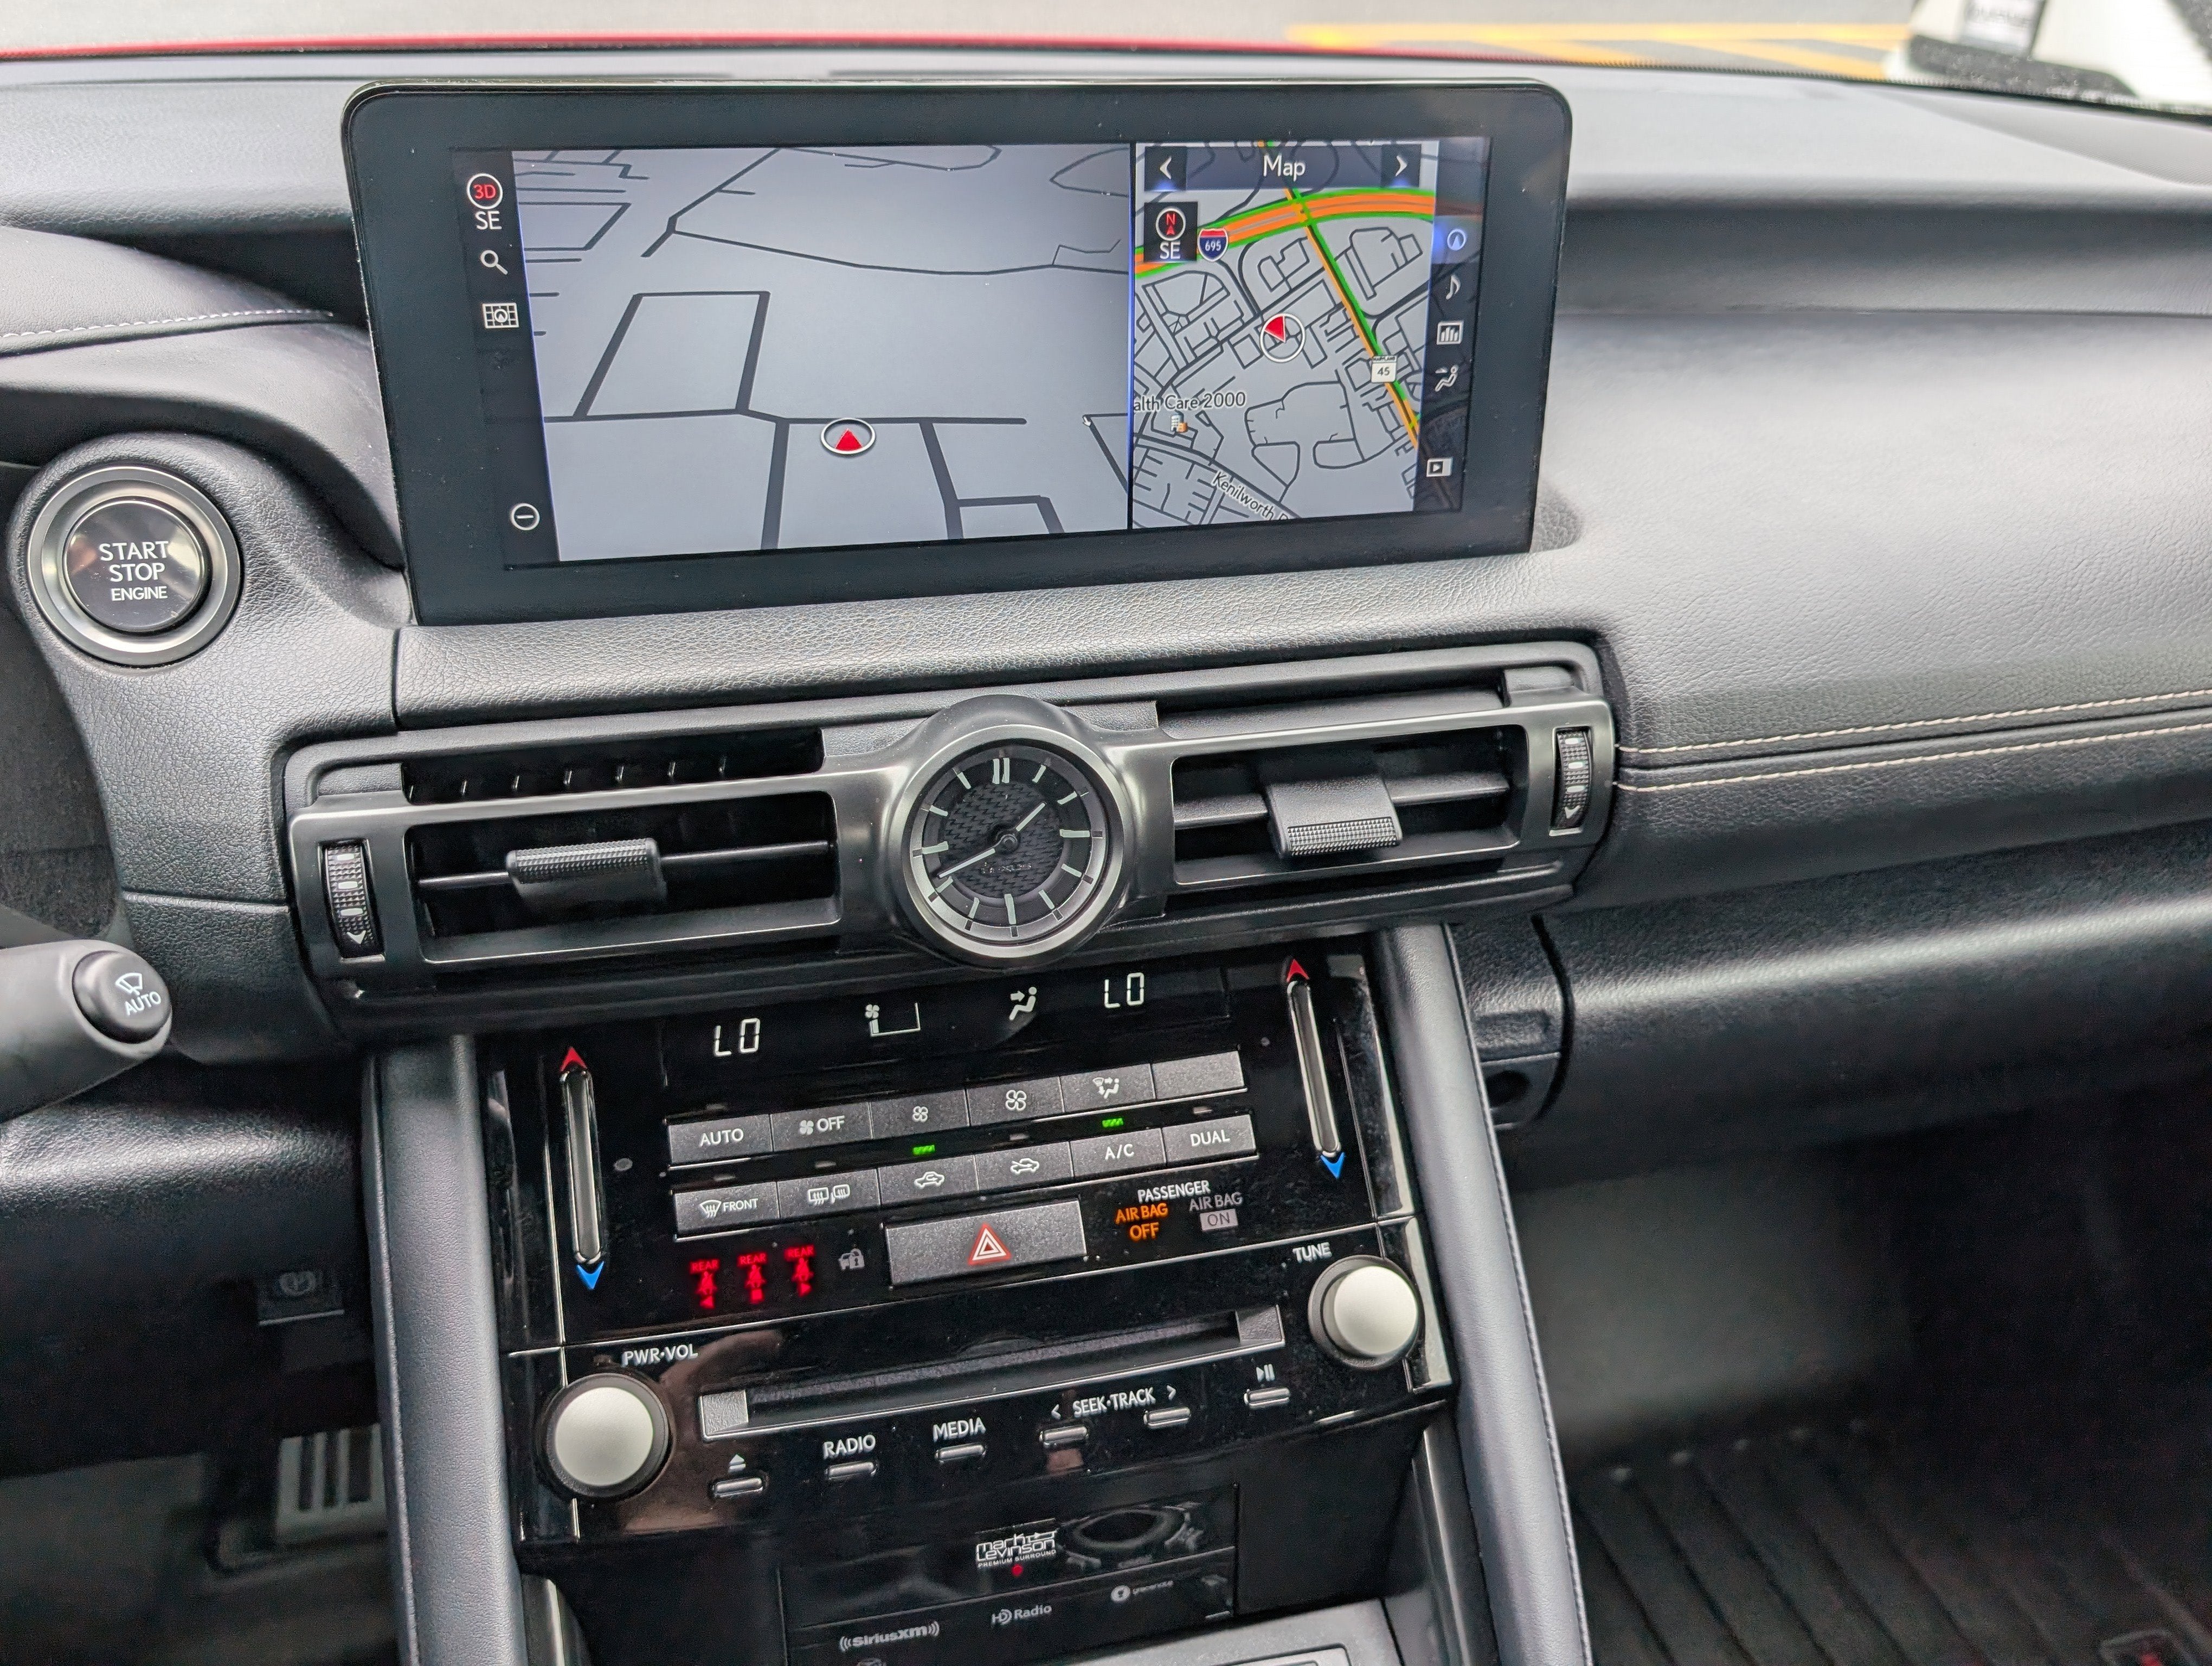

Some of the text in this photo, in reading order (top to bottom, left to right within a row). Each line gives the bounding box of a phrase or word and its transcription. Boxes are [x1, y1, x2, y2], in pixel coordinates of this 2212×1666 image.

[1263, 154, 1306, 182] Map
[473, 184, 497, 200] 3D
[475, 210, 503, 230] SE
[1166, 213, 1176, 226] N
[1159, 241, 1181, 260] SE
[1205, 240, 1221, 252] 695
[1377, 366, 1391, 376] 45
[1165, 395, 1198, 409] Care
[1204, 392, 1246, 408] 2000
[1212, 473, 1274, 520] Kenilworth
[99, 541, 169, 561] START
[110, 562, 165, 582] STOP
[111, 586, 168, 601] ENGINE
[1104, 972, 1144, 1008] LO
[124, 991, 162, 1016] AUTO
[715, 1018, 760, 1056] LO
[816, 1116, 845, 1132] OFF
[699, 1129, 744, 1147] AUTO
[1190, 1129, 1231, 1146] DUAL
[1105, 1144, 1135, 1161] A/C
[1137, 1180, 1211, 1203] PASSENGER
[722, 1198, 758, 1212] FRONT
[1189, 1192, 1243, 1212] AIR BAG
[1115, 1203, 1168, 1225] AIR BAG
[1207, 1212, 1230, 1226] ON
[1129, 1222, 1160, 1241] OFF
[739, 1253, 766, 1265] REAR
[787, 1246, 814, 1258] REAR
[1293, 1242, 1332, 1264] TUNE
[691, 1259, 718, 1272] REAR
[933, 1417, 986, 1442] MEDIA
[823, 1434, 876, 1459] RADIO
[978, 1549, 1057, 1568] PREMIUM SURROUND
[1014, 1604, 1052, 1620] Radio
